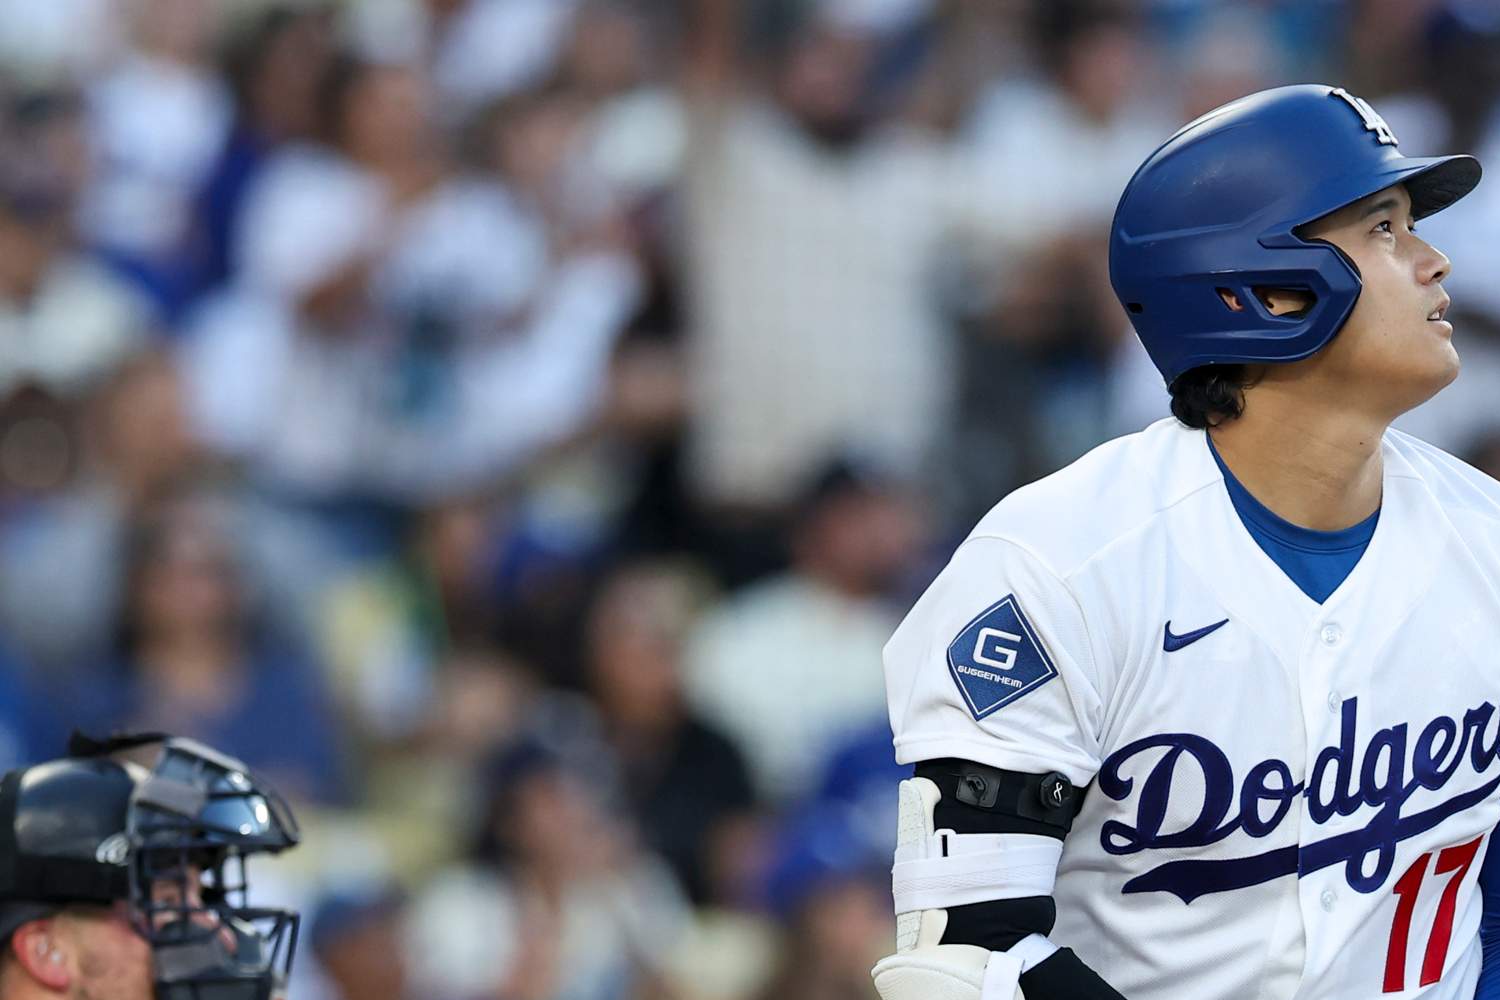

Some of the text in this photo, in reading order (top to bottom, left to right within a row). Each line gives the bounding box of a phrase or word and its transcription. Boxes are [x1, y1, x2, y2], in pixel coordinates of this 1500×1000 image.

[972, 626, 1022, 671] G
[957, 664, 1023, 689] GUGGENHEIM
[1382, 833, 1486, 994] 17
